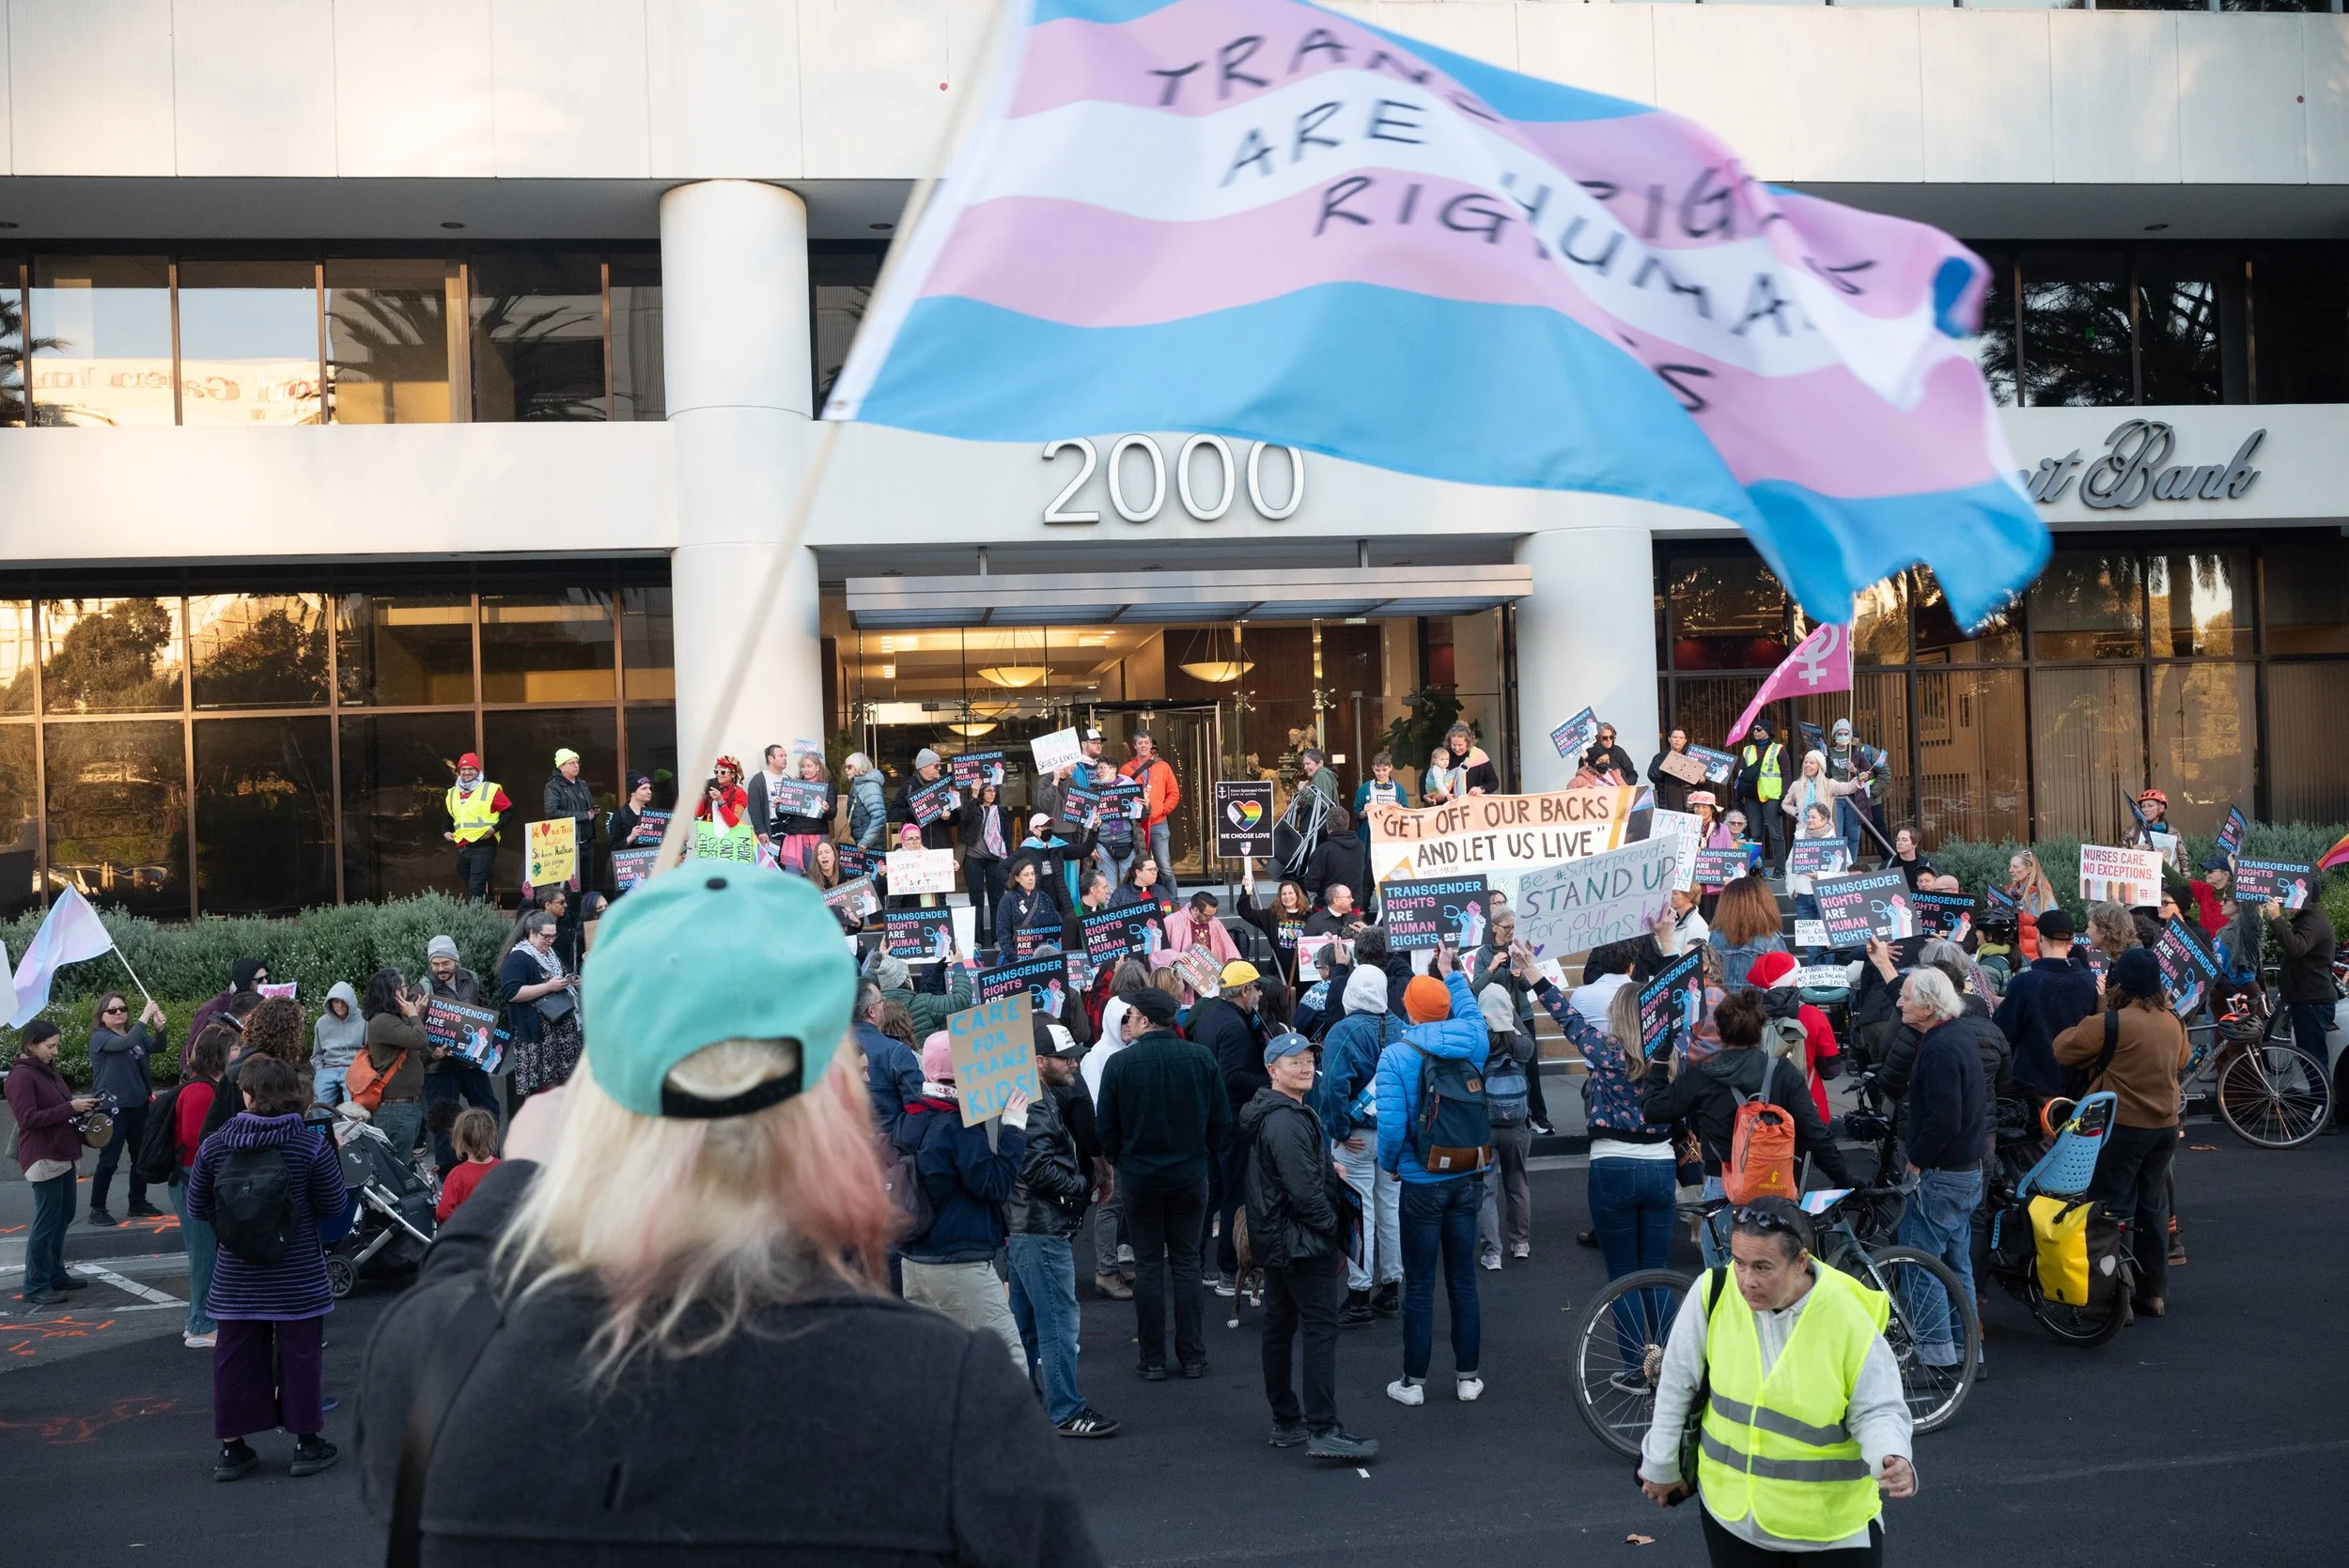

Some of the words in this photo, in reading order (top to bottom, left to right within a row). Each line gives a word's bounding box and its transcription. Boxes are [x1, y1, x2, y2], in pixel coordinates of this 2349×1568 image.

[1219, 99, 1430, 188] ARE
[2078, 418, 2267, 509] Bank
[1041, 433, 1305, 525] 2000
[953, 752, 1003, 763] TRANSGENDER
[1688, 752, 1711, 761] RIGHTS
[1690, 746, 1735, 763] TRANSGENDER
[953, 760, 979, 769] RIGHTS
[955, 772, 979, 782] HUMAN
[956, 779, 974, 787] RIGH
[782, 786, 803, 795] RIGHTS
[783, 781, 825, 792] TRANSGENDER
[909, 775, 953, 802] TRANSGENDER
[1100, 786, 1141, 796] ANSGENDER
[779, 804, 801, 813] RIGHTS
[911, 793, 935, 808] RIGHTS
[914, 803, 928, 814] ARE
[916, 803, 939, 819] HUMAN
[919, 808, 941, 825] RIGHTS
[1436, 805, 1470, 834] OFF
[1484, 800, 1530, 828] OUR
[1540, 796, 1610, 822] BACKS
[638, 835, 662, 844] RIGHTS
[1796, 839, 1844, 847] TRANSGENDER
[614, 850, 661, 861] TRANSGEND
[839, 850, 863, 859] RIGHTS
[1417, 843, 1458, 867] AND
[1463, 834, 1498, 862] LET
[1506, 831, 1535, 860] US
[2084, 848, 2118, 863] NURSES
[2121, 853, 2147, 866] CARE.
[615, 858, 645, 867] RIGHTS
[617, 866, 632, 875] ARE
[2238, 860, 2310, 873] TRANSGENDER
[617, 872, 646, 881] HUMN
[2083, 862, 2094, 874] NO
[2097, 864, 2155, 880] EXCEPTIONS.
[2237, 868, 2274, 877] RIGHTS
[1520, 875, 1548, 892] Be
[1520, 868, 1633, 919] STAND
[1642, 856, 1676, 891] UP
[1816, 874, 1901, 896] TRANSGENDER
[2236, 876, 2256, 884] ARE
[824, 878, 869, 900] RANSGENDER
[1385, 880, 1482, 898] TRANSGENDER
[2236, 884, 2270, 893] HUMAN
[1387, 897, 1436, 910] RIGHTS
[1820, 893, 1863, 909] RIGHTS
[1911, 893, 1975, 907] RANSGENDER
[2235, 892, 2271, 902] RIGHTS
[1825, 908, 1847, 920] ARE
[1914, 902, 1940, 912] GHTS
[886, 910, 948, 922] TRANSGENDER
[1082, 903, 1157, 928] TRANSGENDER
[1388, 910, 1414, 923] ARE
[1524, 916, 1563, 940] for
[1573, 903, 1618, 930] our
[887, 921, 919, 930] RIGHTS
[1017, 925, 1062, 936] TRANSGENDE
[1085, 920, 1123, 937] RIGHTS
[1389, 921, 1436, 934] HUMAN
[1828, 916, 1869, 932] HUMAN
[1088, 933, 1108, 946] ARE
[1391, 933, 1439, 947] RIGHTS
[1564, 914, 1635, 954] trans
[1831, 927, 1874, 944] RIGHTS
[889, 939, 920, 947] HUMAN
[891, 946, 922, 955] RIGHTS
[1089, 938, 1126, 955] HUMAN
[2156, 939, 2174, 959] ARE
[2163, 930, 2191, 962] RIGHTS
[2169, 920, 2217, 979] TRANSGENDER
[1092, 946, 1129, 964] RIGHTS
[1190, 949, 1213, 971] RIGHTS
[1194, 943, 1222, 972] TRANSGE
[982, 959, 1063, 986] TRANSGENDER
[1176, 964, 1200, 986] RIGHTS
[1640, 954, 1699, 1007] TRANSGENDER
[983, 979, 1022, 998] RIGHTS
[431, 1000, 494, 1022] TRANSGENDER
[1641, 987, 1669, 1020] RIGHTS
[426, 1017, 444, 1027] ARE
[428, 1008, 461, 1022] RIGHTS
[951, 998, 1020, 1036] CARE
[1642, 1010, 1657, 1032] ARE
[1643, 1012, 1669, 1046] HUMAN
[428, 1034, 456, 1048] IGHTS
[972, 1031, 1008, 1055] FOR
[1644, 1024, 1670, 1060] RIGHTS
[960, 1045, 1028, 1084] TRANS
